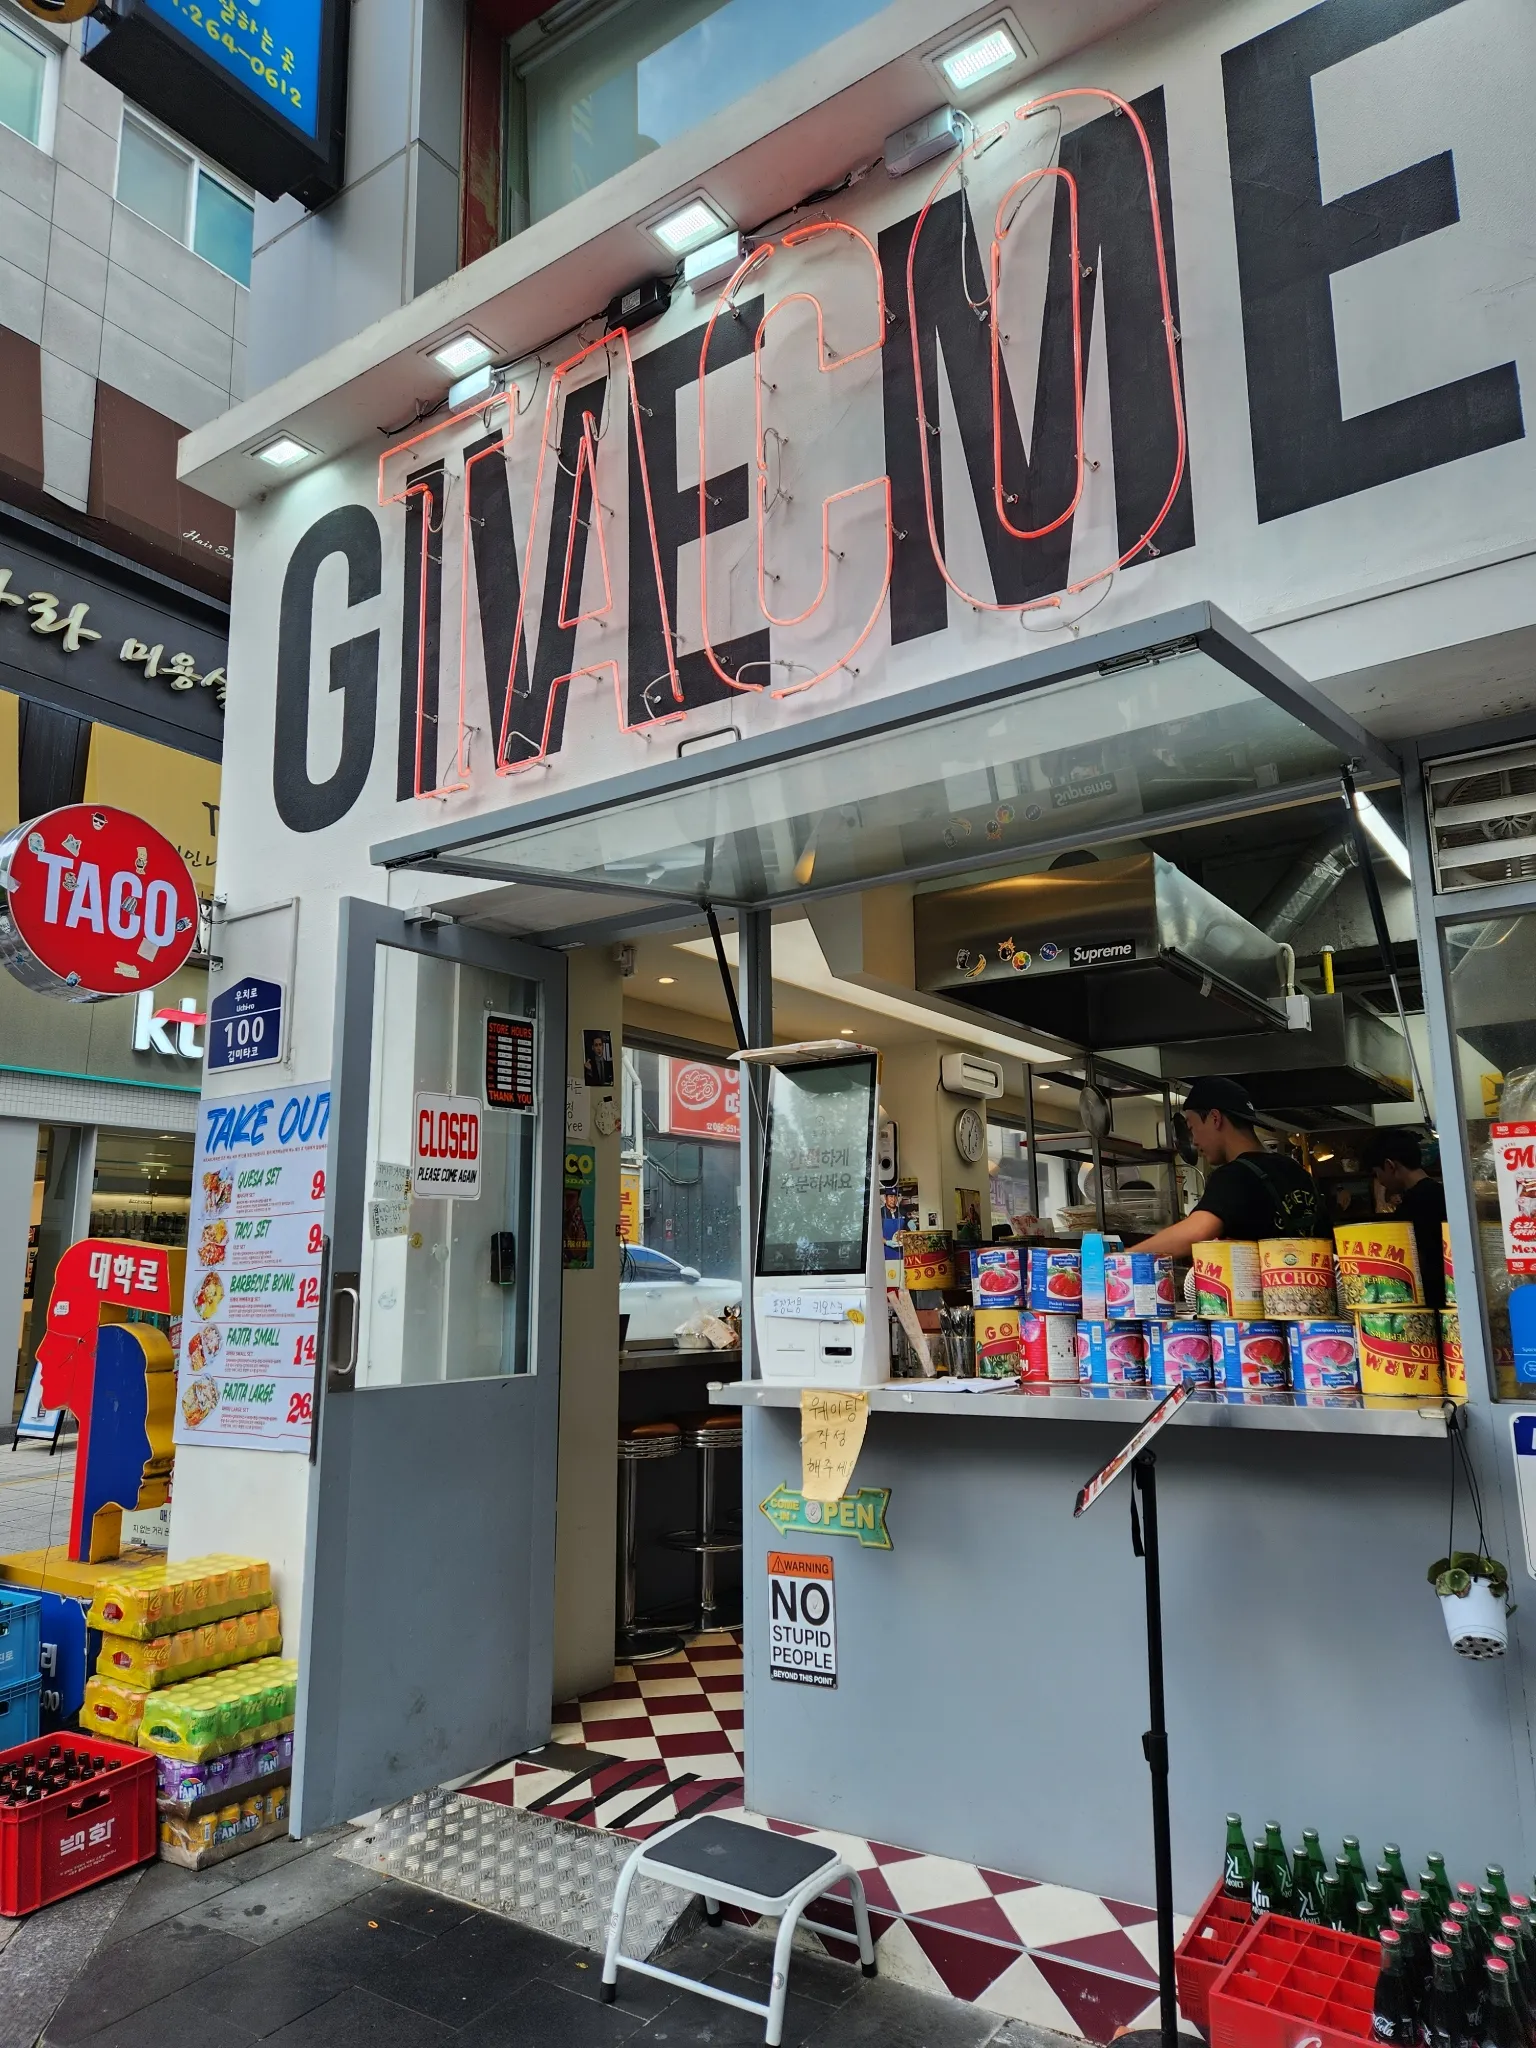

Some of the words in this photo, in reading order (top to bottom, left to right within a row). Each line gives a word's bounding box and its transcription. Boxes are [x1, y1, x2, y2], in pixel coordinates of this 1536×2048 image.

[172, 0, 302, 109] .264-0612
[272, 293, 771, 833] GIVE
[878, 0, 1526, 645] ME
[183, 530, 213, 549] Hair
[215, 546, 234, 559] Sa
[37, 851, 178, 947] TACO
[1073, 943, 1132, 963] Supreme
[235, 988, 258, 1001] 우치로
[224, 1016, 264, 1047] 100
[488, 1022, 509, 1036] STORE
[511, 1025, 533, 1038] HOURS
[488, 1090, 514, 1103] THANK
[517, 1093, 532, 1105] YOU
[205, 1099, 275, 1155] TAKE
[278, 1092, 331, 1145] OUT
[418, 1109, 479, 1160] CLOSED
[265, 1167, 283, 1188] SET
[417, 1166, 439, 1182] PLEASE
[440, 1168, 457, 1182] COME
[458, 1169, 477, 1183] AGAIN
[234, 1221, 253, 1240] TACO
[254, 1220, 272, 1239] SET
[1311, 1252, 1331, 1269] FA
[1343, 1240, 1405, 1264] FARM
[89, 1252, 159, 1294] 대학로
[1195, 1259, 1223, 1279] RM
[1264, 1271, 1328, 1287] NACHOS
[230, 1273, 271, 1293] BARBECUE
[272, 1273, 296, 1292] BOWL
[226, 1328, 251, 1346] FAJITA
[253, 1328, 279, 1346] SMALL
[1366, 1351, 1429, 1381] FARM
[222, 1383, 248, 1401] FAJITA
[248, 1383, 276, 1405] LARGE
[808, 1396, 858, 1423] 웨이팅
[816, 1429, 846, 1448] 작성
[806, 1458, 850, 1479] 해주세
[770, 1498, 800, 1511] COME
[805, 1501, 875, 1530] PEN
[784, 1560, 829, 1575] WARNING
[772, 1578, 830, 1627] NO
[773, 1626, 831, 1649] STUPID
[773, 1647, 833, 1670] PEOPLE
[773, 1669, 798, 1682] BEYOND
[799, 1672, 813, 1683] THIS
[813, 1674, 833, 1686] POINT
[259, 1756, 279, 1773] FANT
[1252, 1881, 1270, 1909] Kin
